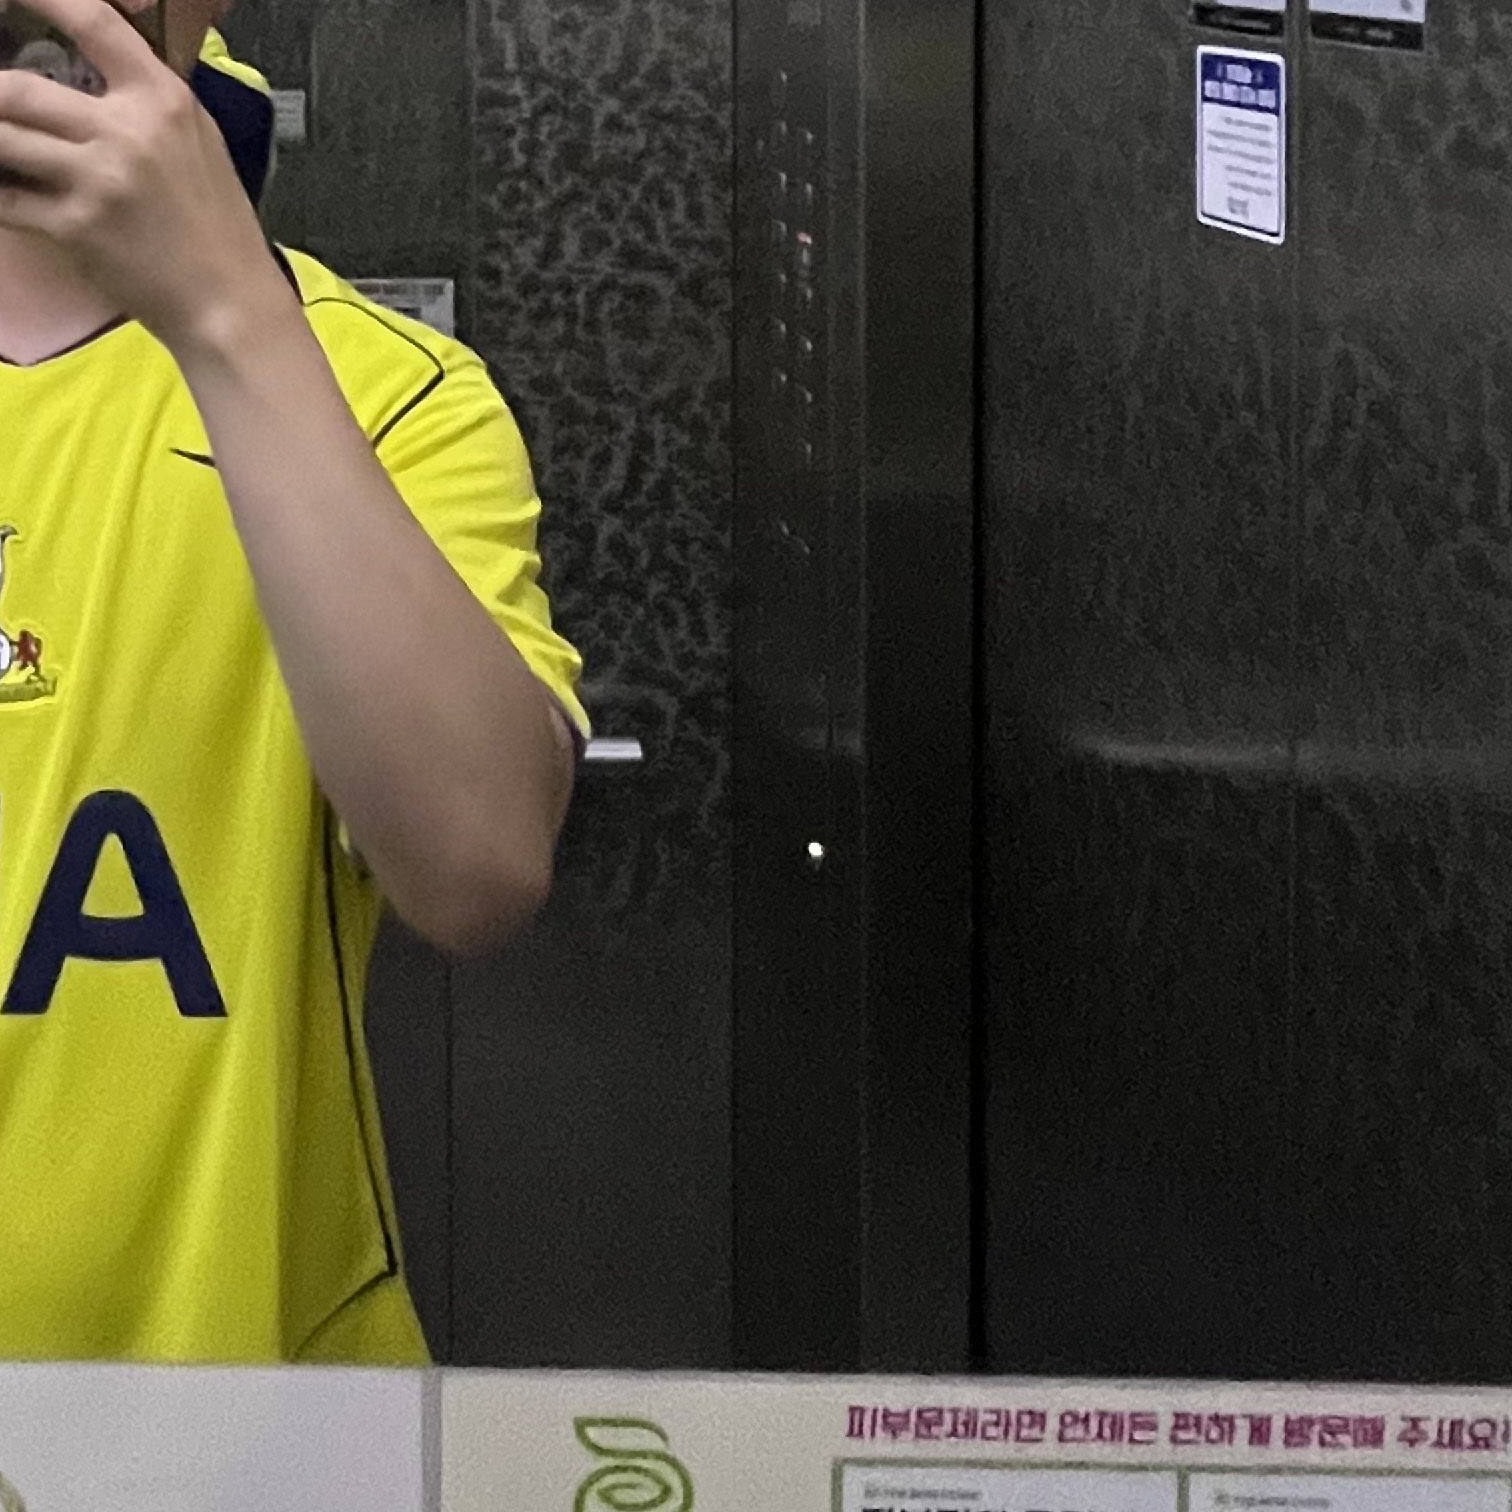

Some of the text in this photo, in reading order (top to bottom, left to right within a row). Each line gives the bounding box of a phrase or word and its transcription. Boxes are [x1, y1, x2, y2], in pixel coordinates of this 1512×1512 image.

[845, 1404, 1047, 1443] 피부문제라면
[1057, 1408, 1159, 1445] 언제든
[1170, 1411, 1274, 1448] 편하게
